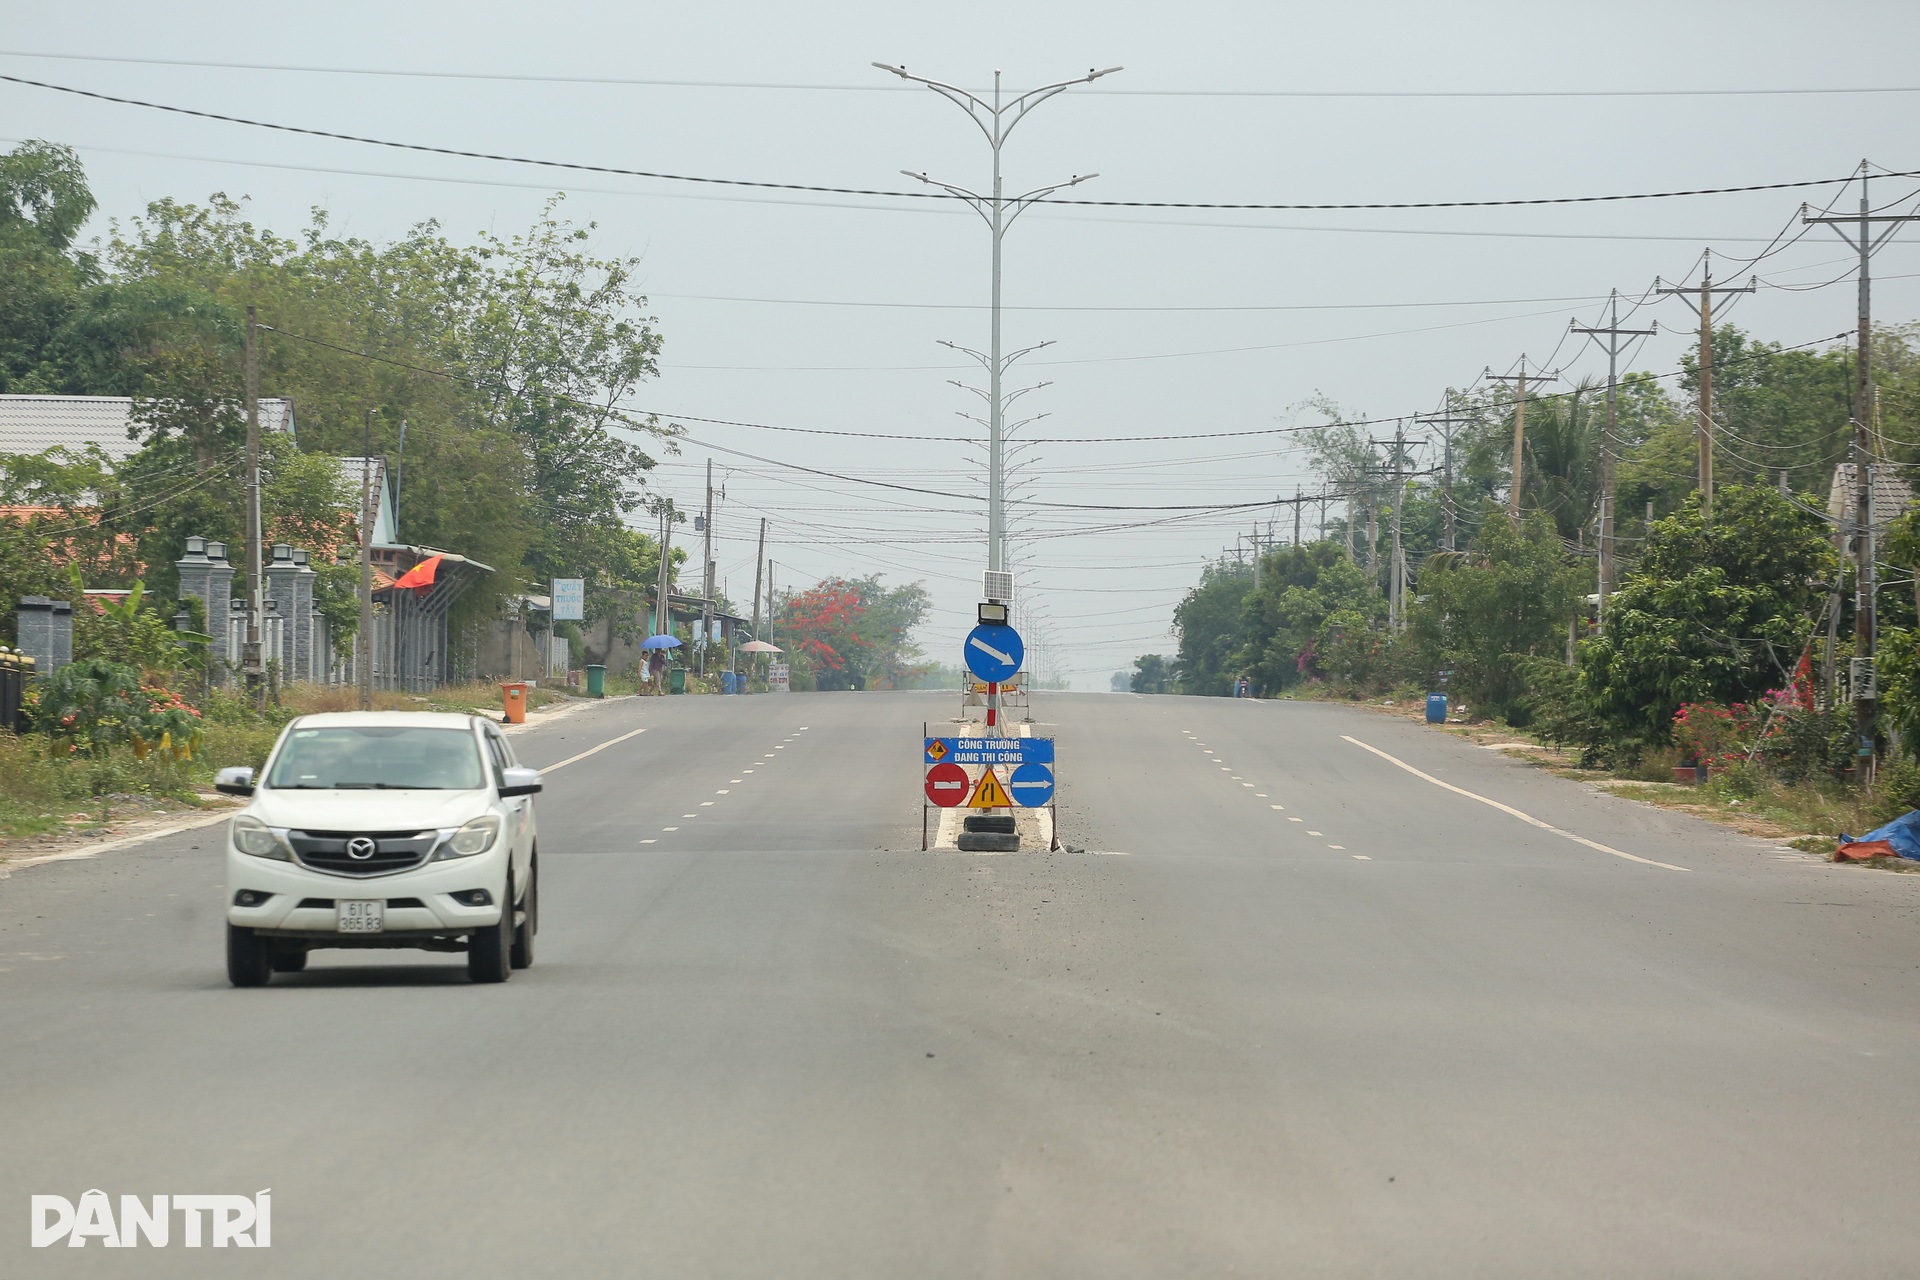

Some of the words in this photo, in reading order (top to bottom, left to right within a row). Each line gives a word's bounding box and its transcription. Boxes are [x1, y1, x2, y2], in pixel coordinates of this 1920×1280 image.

[958, 739, 982, 750] CÔNG
[954, 752, 979, 762] ĐANG
[981, 752, 996, 762] THI
[998, 751, 1023, 762] CÔNG
[350, 903, 372, 916] 61C
